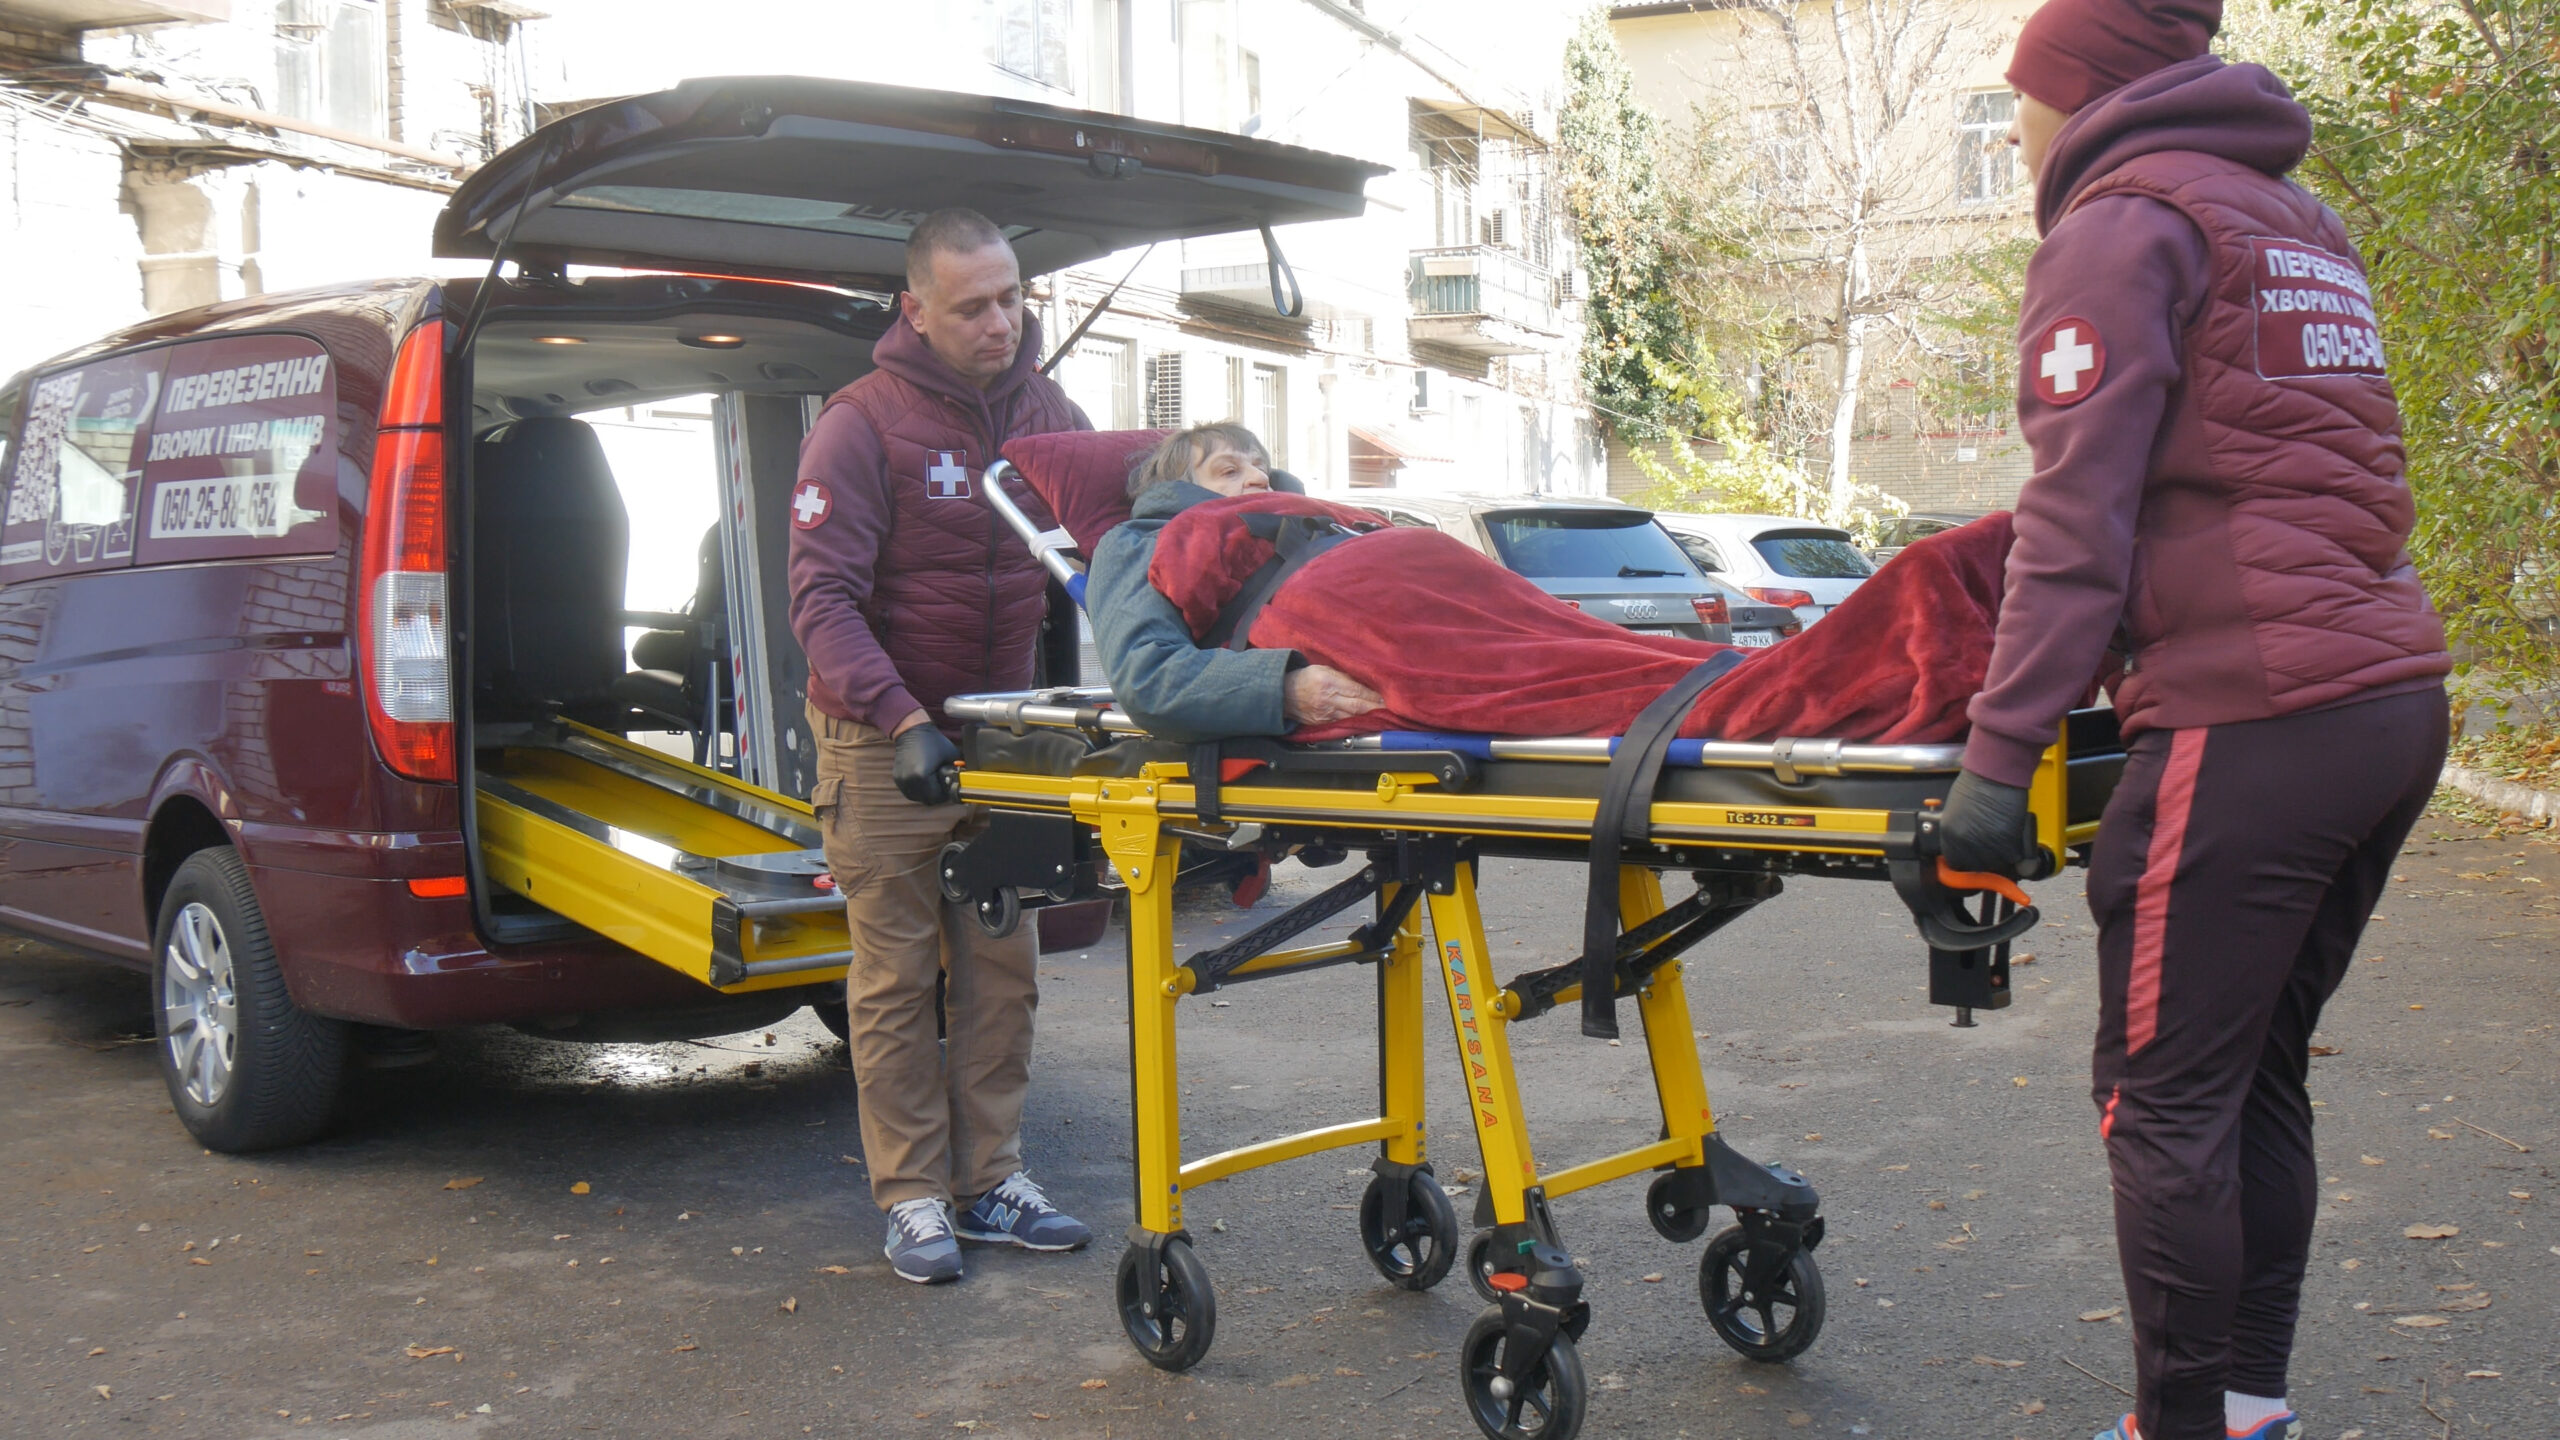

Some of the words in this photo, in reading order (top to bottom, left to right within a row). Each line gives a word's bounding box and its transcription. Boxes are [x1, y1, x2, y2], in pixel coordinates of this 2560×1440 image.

[2260, 288, 2343, 315] ХВОРИХ
[166, 354, 329, 414] ПЕРЕВЕЗЕННЯ
[147, 427, 216, 462] ХВОРИХ
[161, 482, 280, 531] 050-25-88-652
[1727, 812, 1778, 825] TG-242
[1446, 945, 1498, 1128] KARTSANA
[986, 1201, 1021, 1233] N
